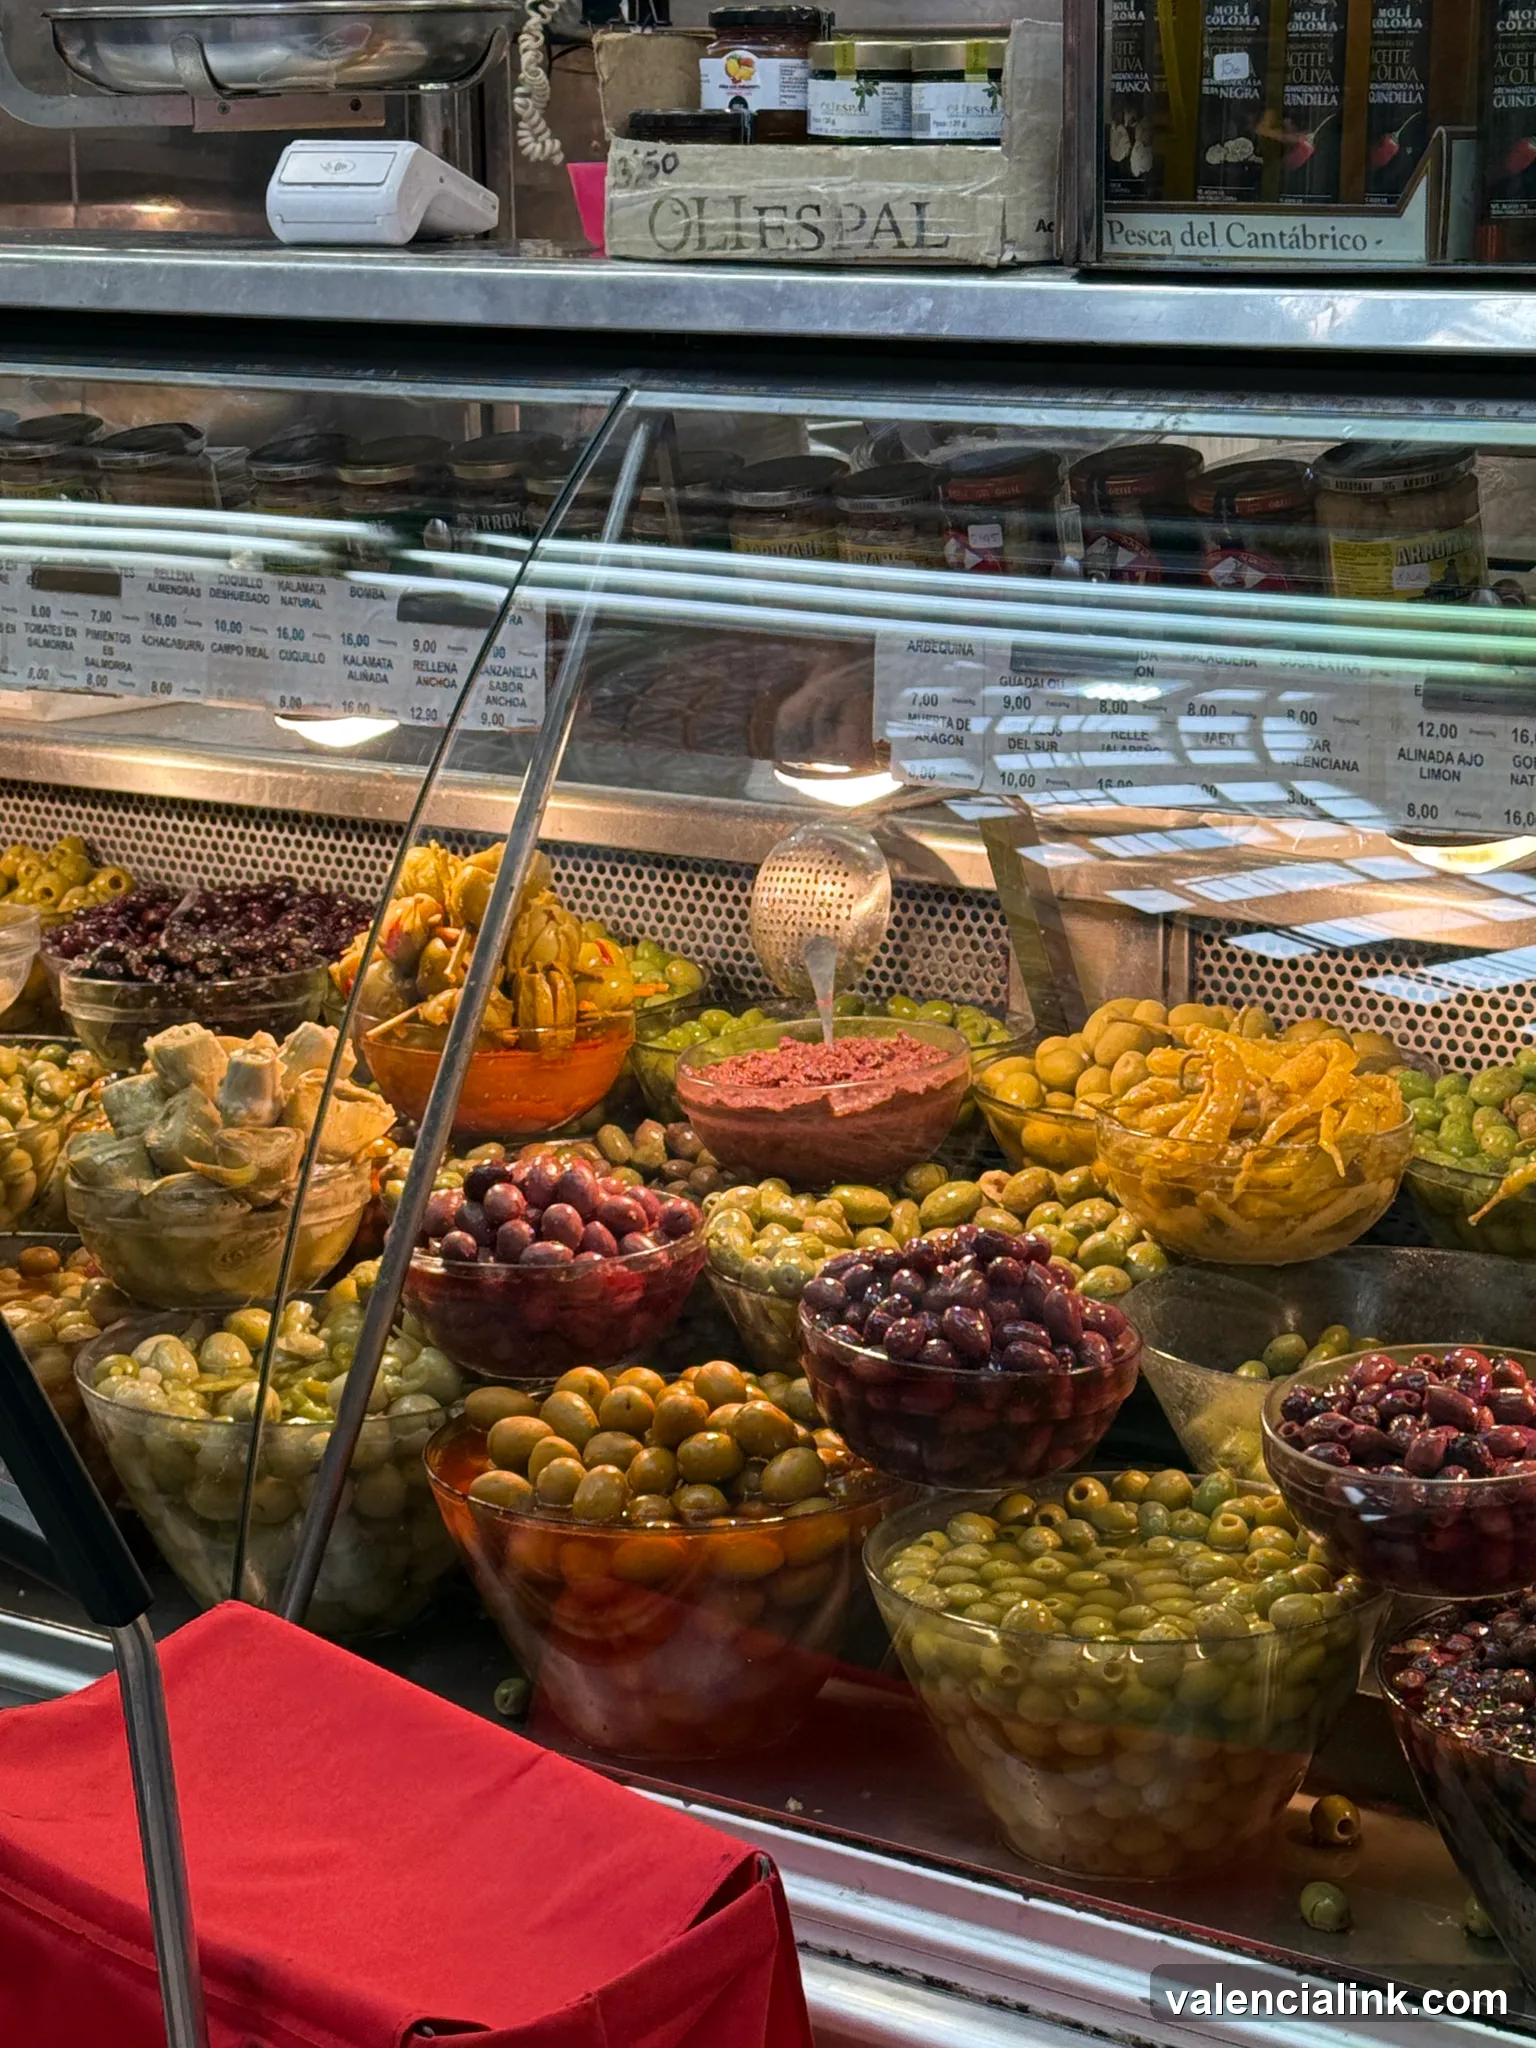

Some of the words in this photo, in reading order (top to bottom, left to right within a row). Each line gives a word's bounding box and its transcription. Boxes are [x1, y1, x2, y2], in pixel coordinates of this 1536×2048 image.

[1205, 15, 1260, 26] COLOMA
[1292, 66, 1335, 84] OLIVA
[1376, 64, 1420, 81] OLIVA
[1219, 86, 1260, 99] NEGRA
[649, 195, 949, 253] OLIESPAL
[1106, 219, 1172, 248] Pesca
[1181, 219, 1218, 249] del
[1225, 222, 1368, 252] Cantábrico
[217, 573, 264, 589] CUQUILLO
[277, 580, 327, 596] KALAMATA
[147, 583, 202, 598] ALMENDRAS
[209, 587, 270, 605] DESHUESADO
[349, 585, 387, 601] BOMBA
[280, 595, 323, 611] NATURAL
[24, 622, 63, 637] TOMATES
[65, 626, 78, 639] EN
[85, 627, 132, 645] PIMIENTOS
[26, 636, 75, 652] SALMORRA
[210, 641, 244, 657] CAMPO
[245, 645, 270, 660] REAL
[906, 639, 976, 657] ARBEQUINA
[84, 656, 133, 673] SALMORRA
[279, 649, 326, 665] CUQUILLO
[343, 654, 394, 670] KALAMATA
[412, 659, 458, 675] RELLENA
[480, 664, 538, 681] ANZANILLA
[415, 675, 458, 690] ANCHOA
[488, 680, 525, 694] SABOR
[484, 695, 528, 709] ANCHOA
[910, 692, 939, 708] 7,00
[1002, 695, 1032, 712] 9,00
[955, 717, 972, 732] DE
[1416, 720, 1458, 740] 12,00
[1007, 737, 1031, 751] DEL
[1034, 740, 1060, 753] SUR
[1511, 727, 1536, 746] 16,
[1281, 756, 1360, 773] ALENCIANA
[1456, 751, 1485, 768] AJO
[999, 771, 1036, 789] 10,00
[1419, 766, 1461, 783] LIMON
[1406, 802, 1439, 820] 8,00
[1504, 808, 1536, 829] 16,0
